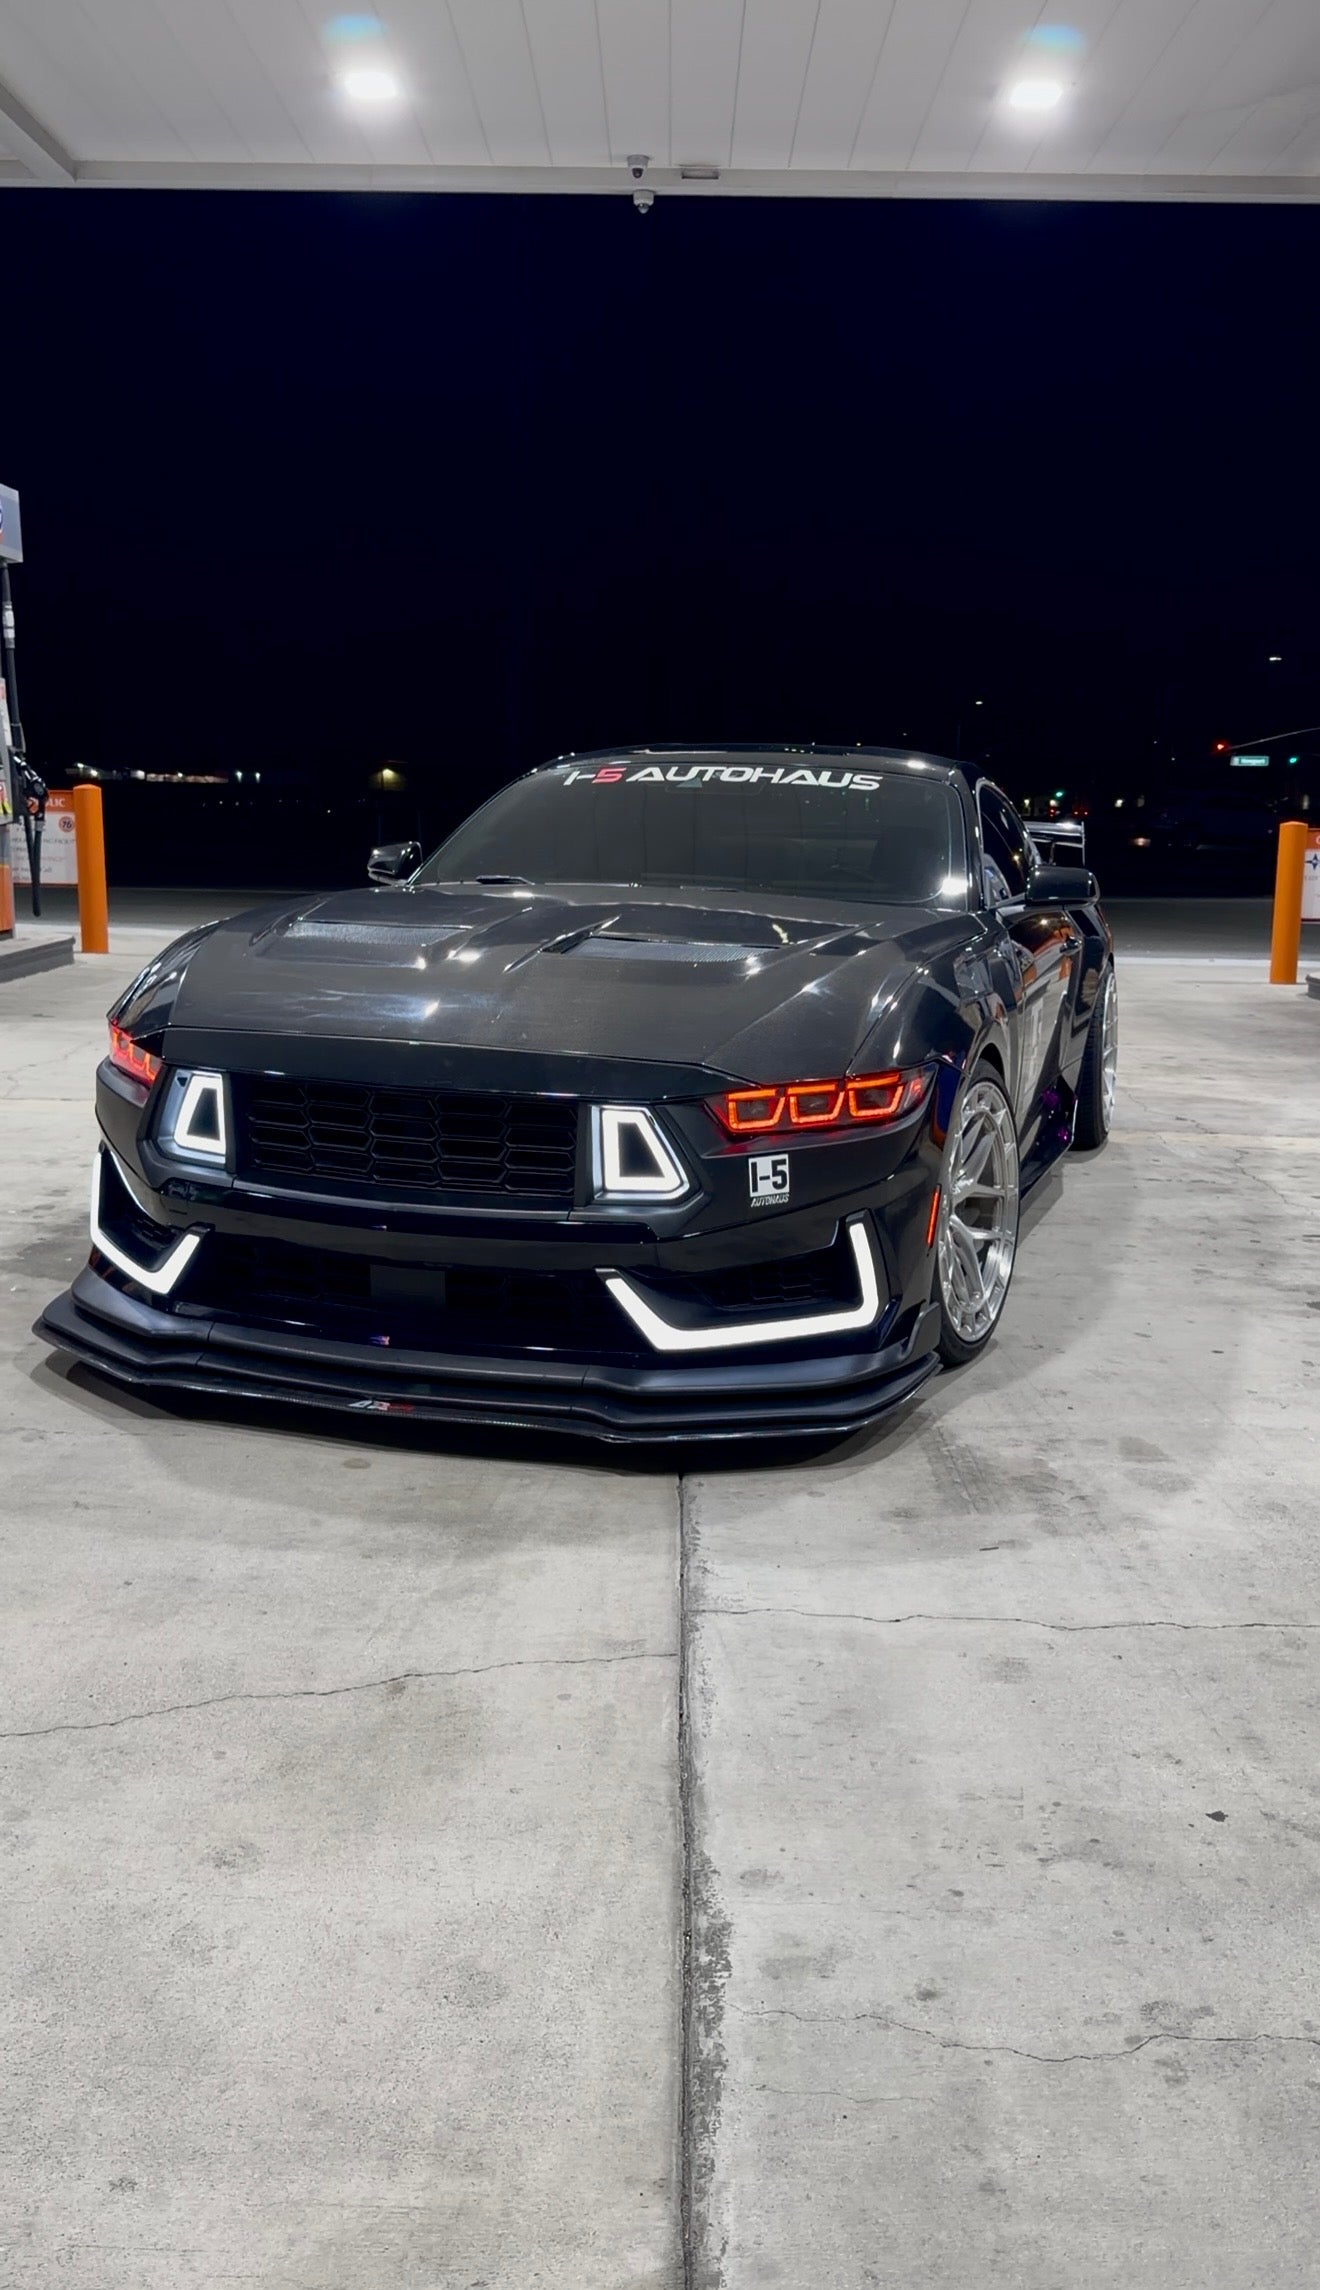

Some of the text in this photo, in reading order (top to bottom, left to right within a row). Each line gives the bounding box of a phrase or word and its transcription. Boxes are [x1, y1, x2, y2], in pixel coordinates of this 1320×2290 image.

[563, 766, 883, 791] I-5 AUTOHAUS
[750, 1158, 788, 1193] I-5
[750, 1193, 790, 1208] AUTOHAUS
